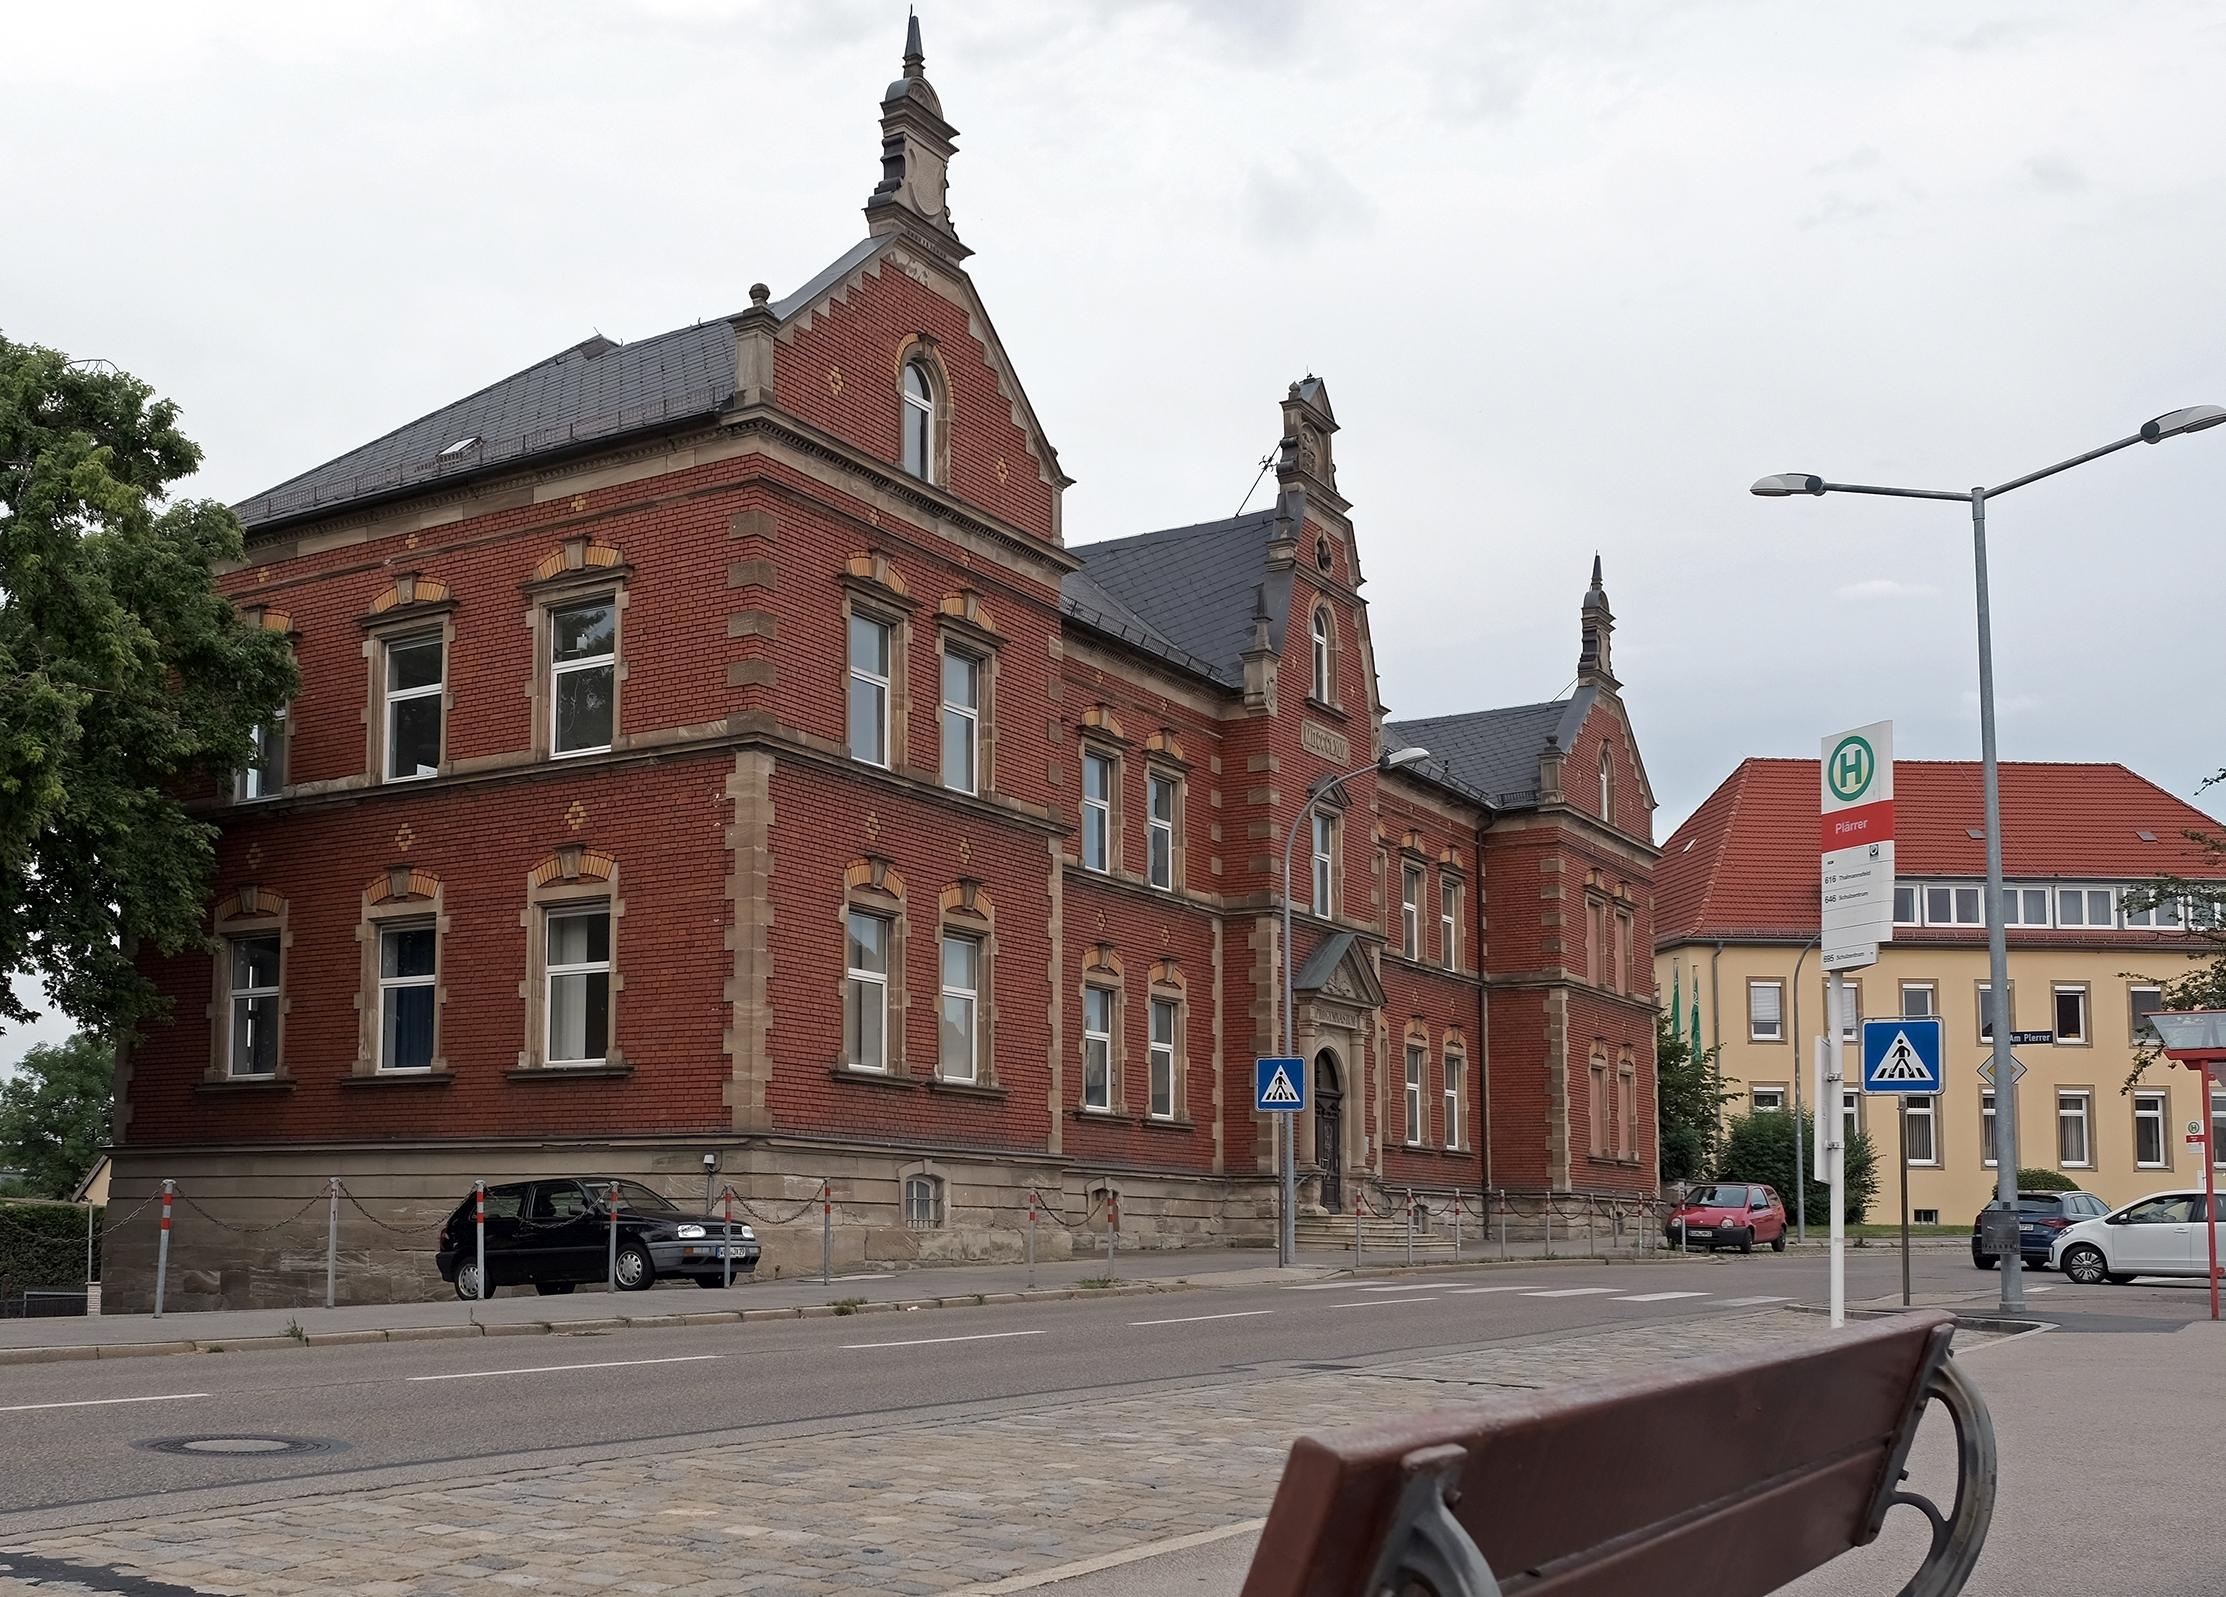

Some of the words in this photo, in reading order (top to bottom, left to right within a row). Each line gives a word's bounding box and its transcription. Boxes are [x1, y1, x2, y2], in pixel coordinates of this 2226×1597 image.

[1840, 749, 1862, 788] H
[1835, 819, 1868, 834] Plärrer
[2010, 1033, 2021, 1042] Am
